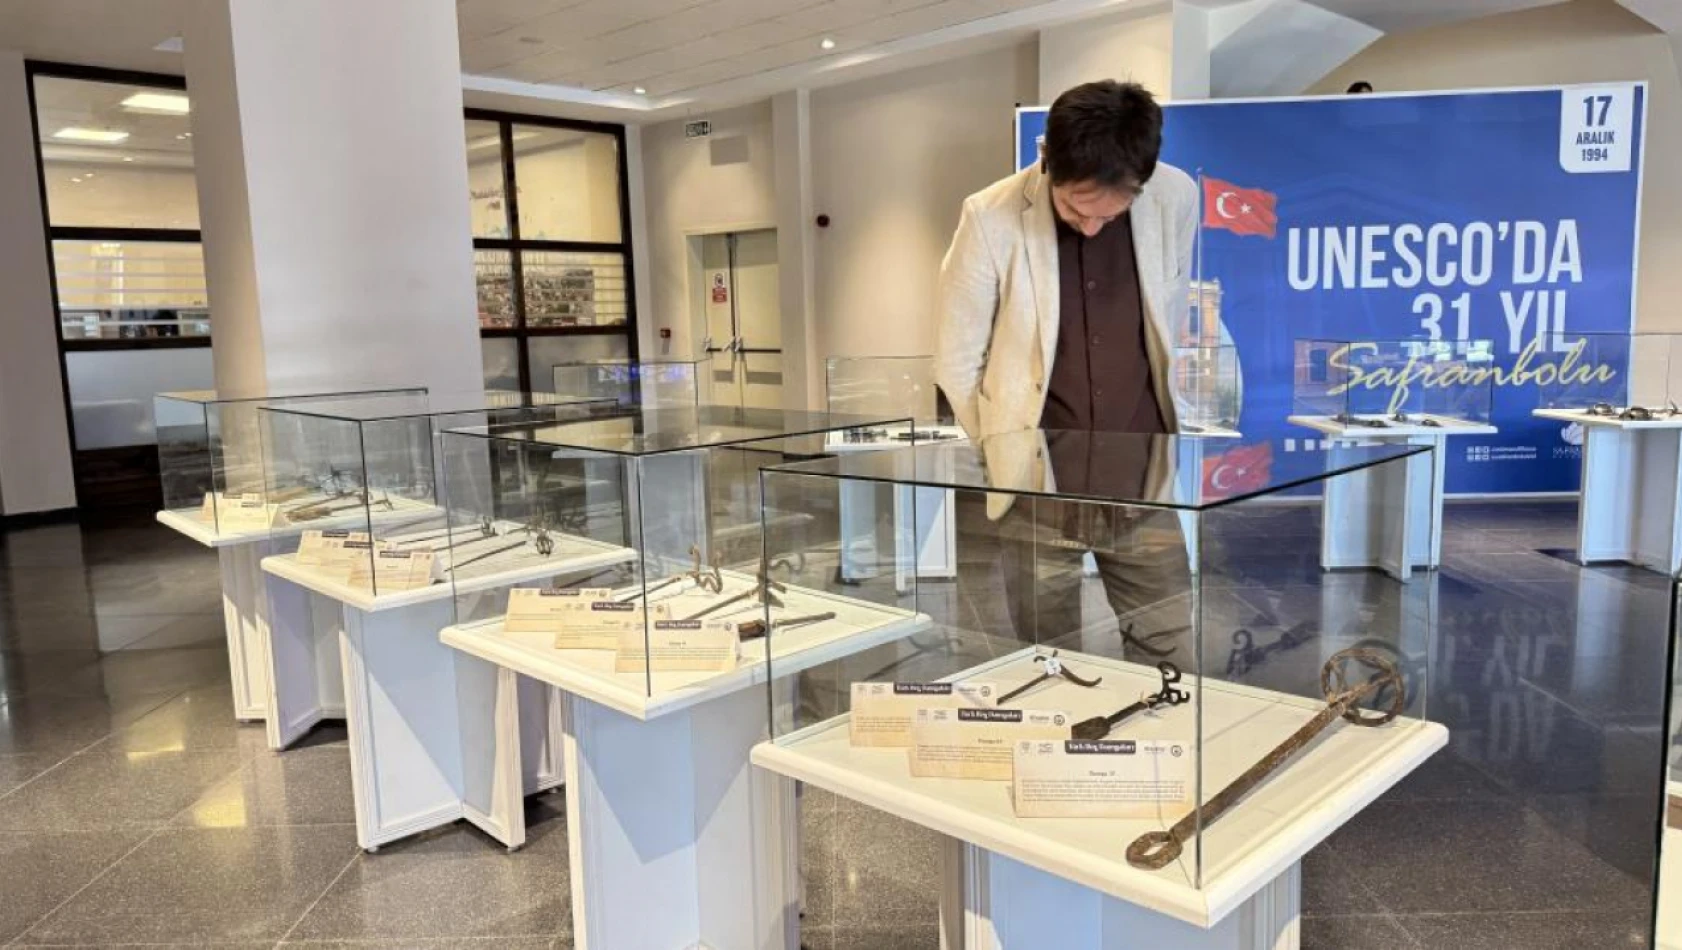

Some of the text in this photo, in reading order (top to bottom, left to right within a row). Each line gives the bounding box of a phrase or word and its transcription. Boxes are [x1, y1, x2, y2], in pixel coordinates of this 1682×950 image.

[1583, 95, 1612, 127] 17
[1576, 131, 1615, 145] ARALIK
[1581, 148, 1608, 162] 1994
[1287, 219, 1583, 290] UNESCO'DA
[1411, 289, 1571, 355] 31 YIL
[1326, 336, 1617, 415] Safranbolu
